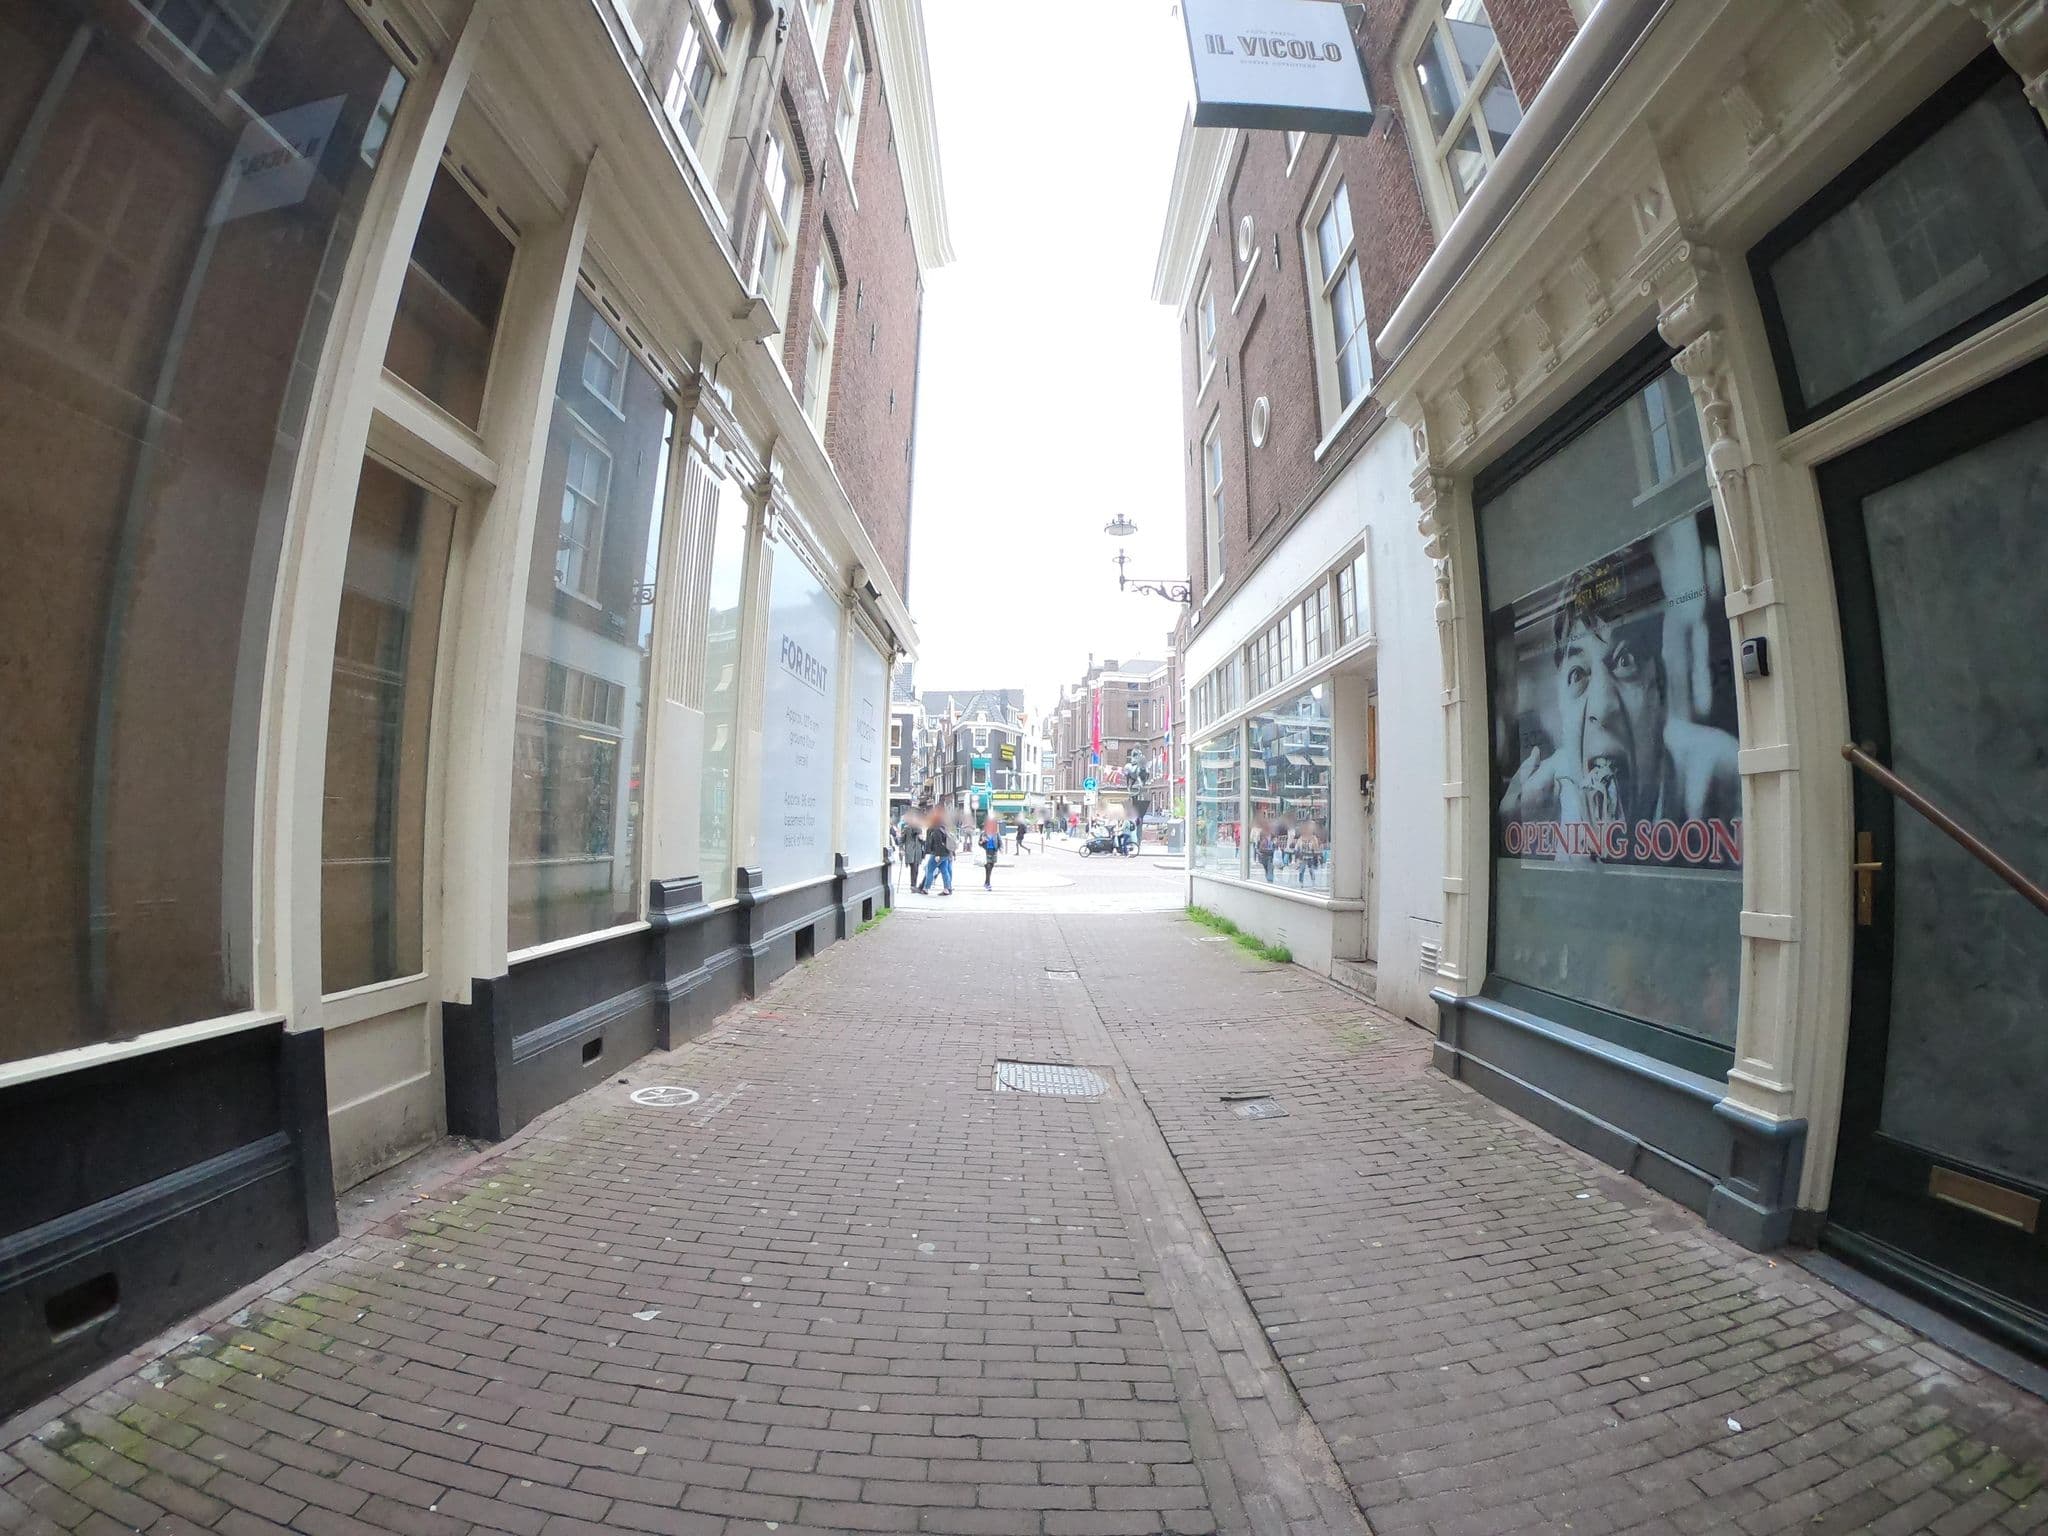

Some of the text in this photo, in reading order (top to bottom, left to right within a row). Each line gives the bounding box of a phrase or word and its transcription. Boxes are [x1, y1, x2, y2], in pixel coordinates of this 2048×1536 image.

[1205, 34, 1342, 62] IL VICOLO
[780, 633, 828, 692] FOR RENT
[1505, 818, 1743, 865] OPENING SOON
